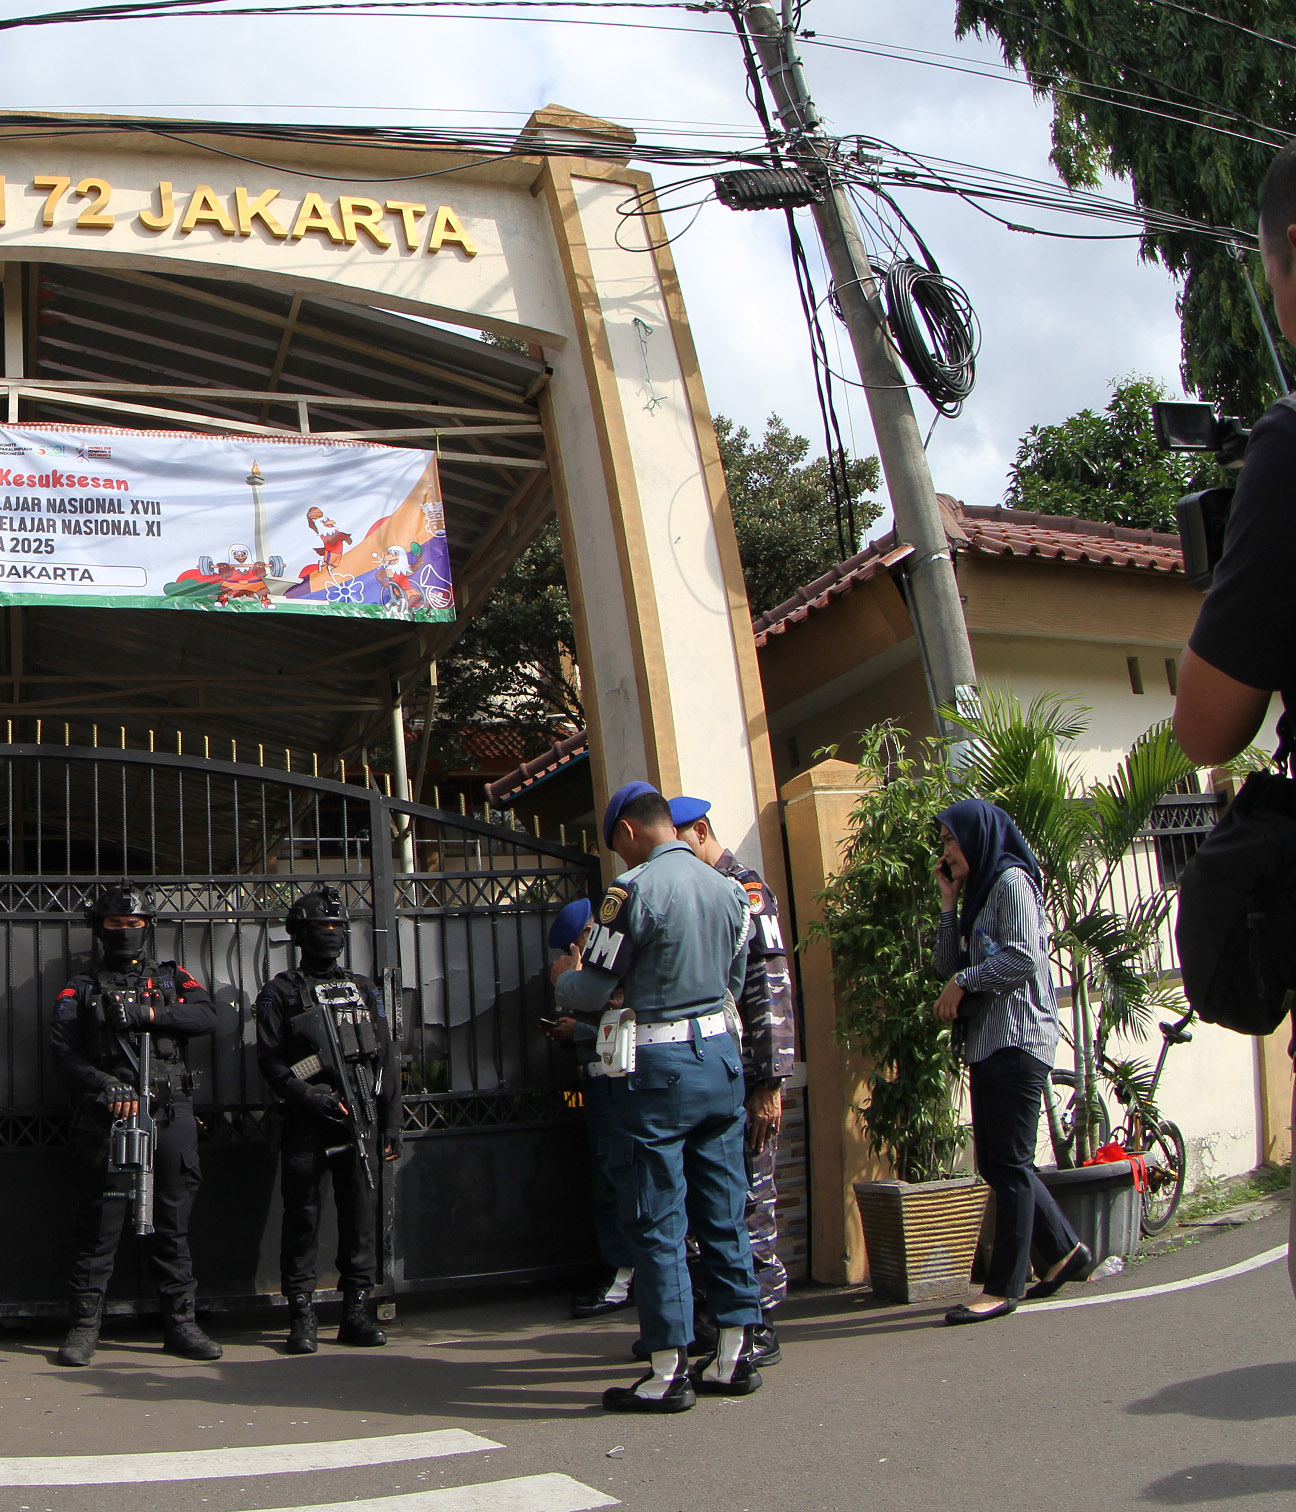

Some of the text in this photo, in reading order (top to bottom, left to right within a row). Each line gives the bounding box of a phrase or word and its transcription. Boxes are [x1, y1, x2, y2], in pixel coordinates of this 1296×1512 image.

[34, 175, 114, 228] 72
[139, 181, 478, 256] JAKARTA
[47, 498, 125, 515] NASIONAL
[130, 500, 161, 515] XVII
[61, 519, 140, 536] NASIONAL
[145, 520, 161, 536] XI
[9, 537, 54, 554] 2025
[750, 914, 784, 949] M
[582, 922, 624, 970] PM
